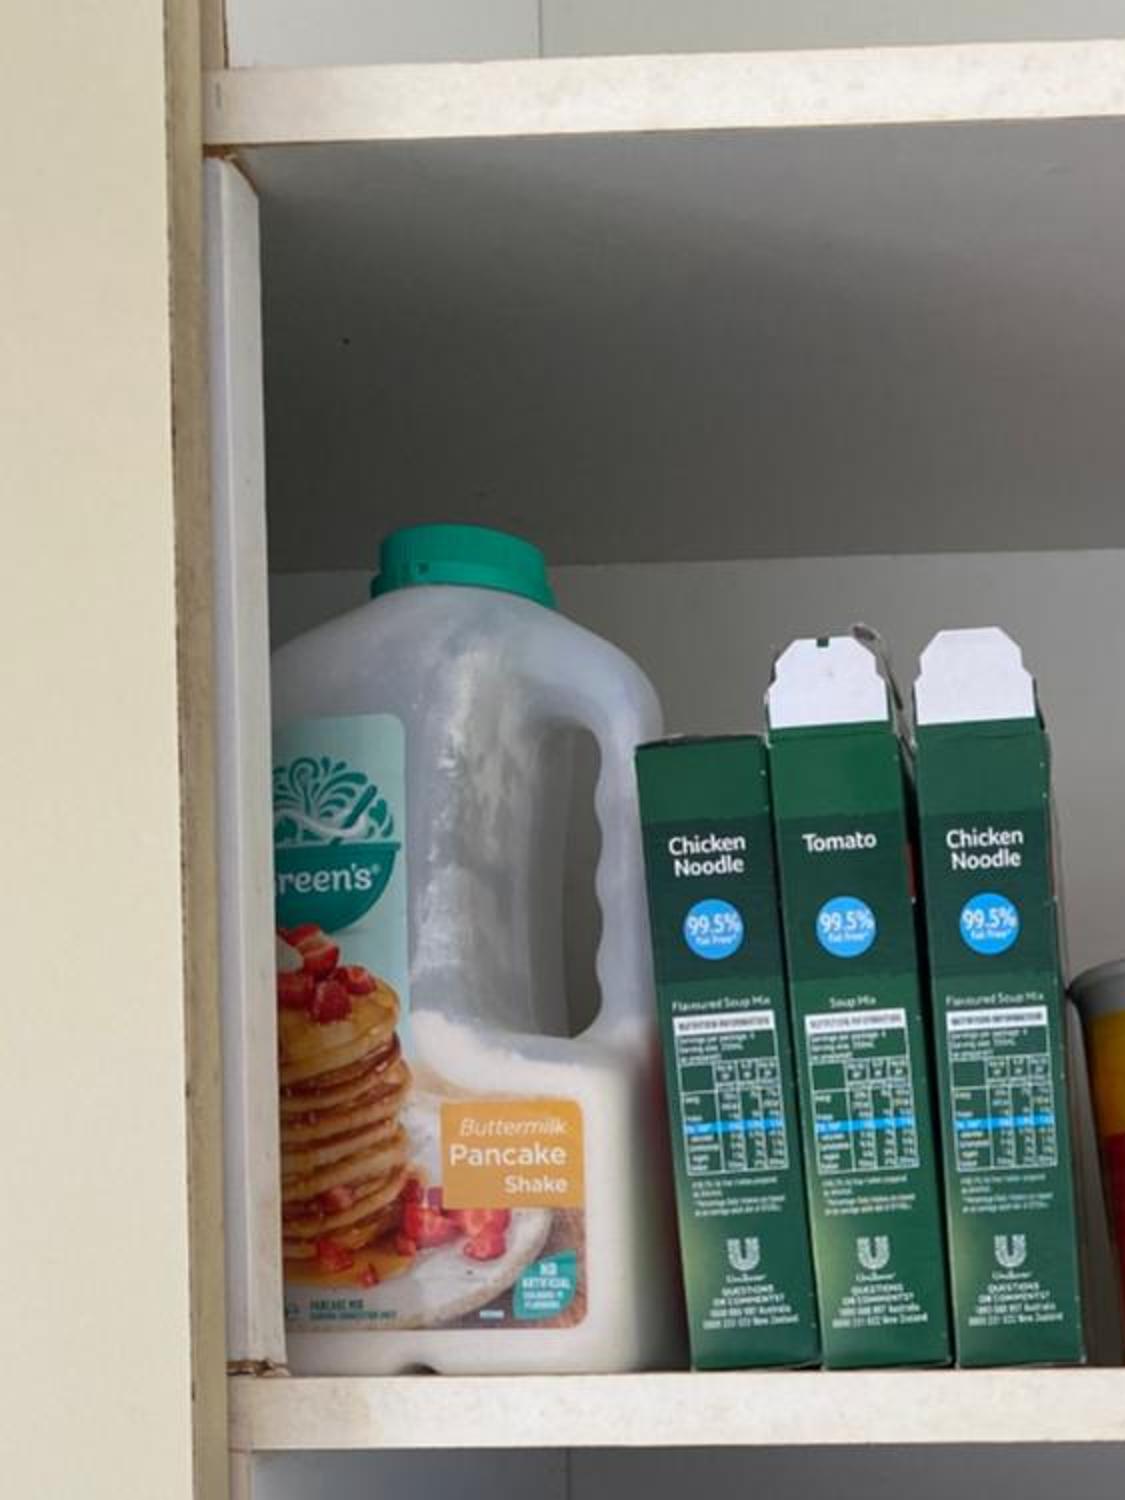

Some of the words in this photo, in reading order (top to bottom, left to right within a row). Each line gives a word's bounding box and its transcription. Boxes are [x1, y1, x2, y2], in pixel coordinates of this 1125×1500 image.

[668, 834, 746, 856] Chicken
[802, 831, 877, 852] Tomato
[946, 828, 1024, 850] Chicken
[674, 855, 744, 878] Noodle
[952, 849, 1021, 870] Noodle
[278, 863, 373, 894] reen's
[687, 912, 740, 936] 99.5%
[819, 910, 874, 933] 99.5%
[964, 907, 1018, 929] 99.5%
[460, 1117, 568, 1137] Buttermilk
[449, 1144, 568, 1167] Pancake
[504, 1175, 568, 1194] Shake
